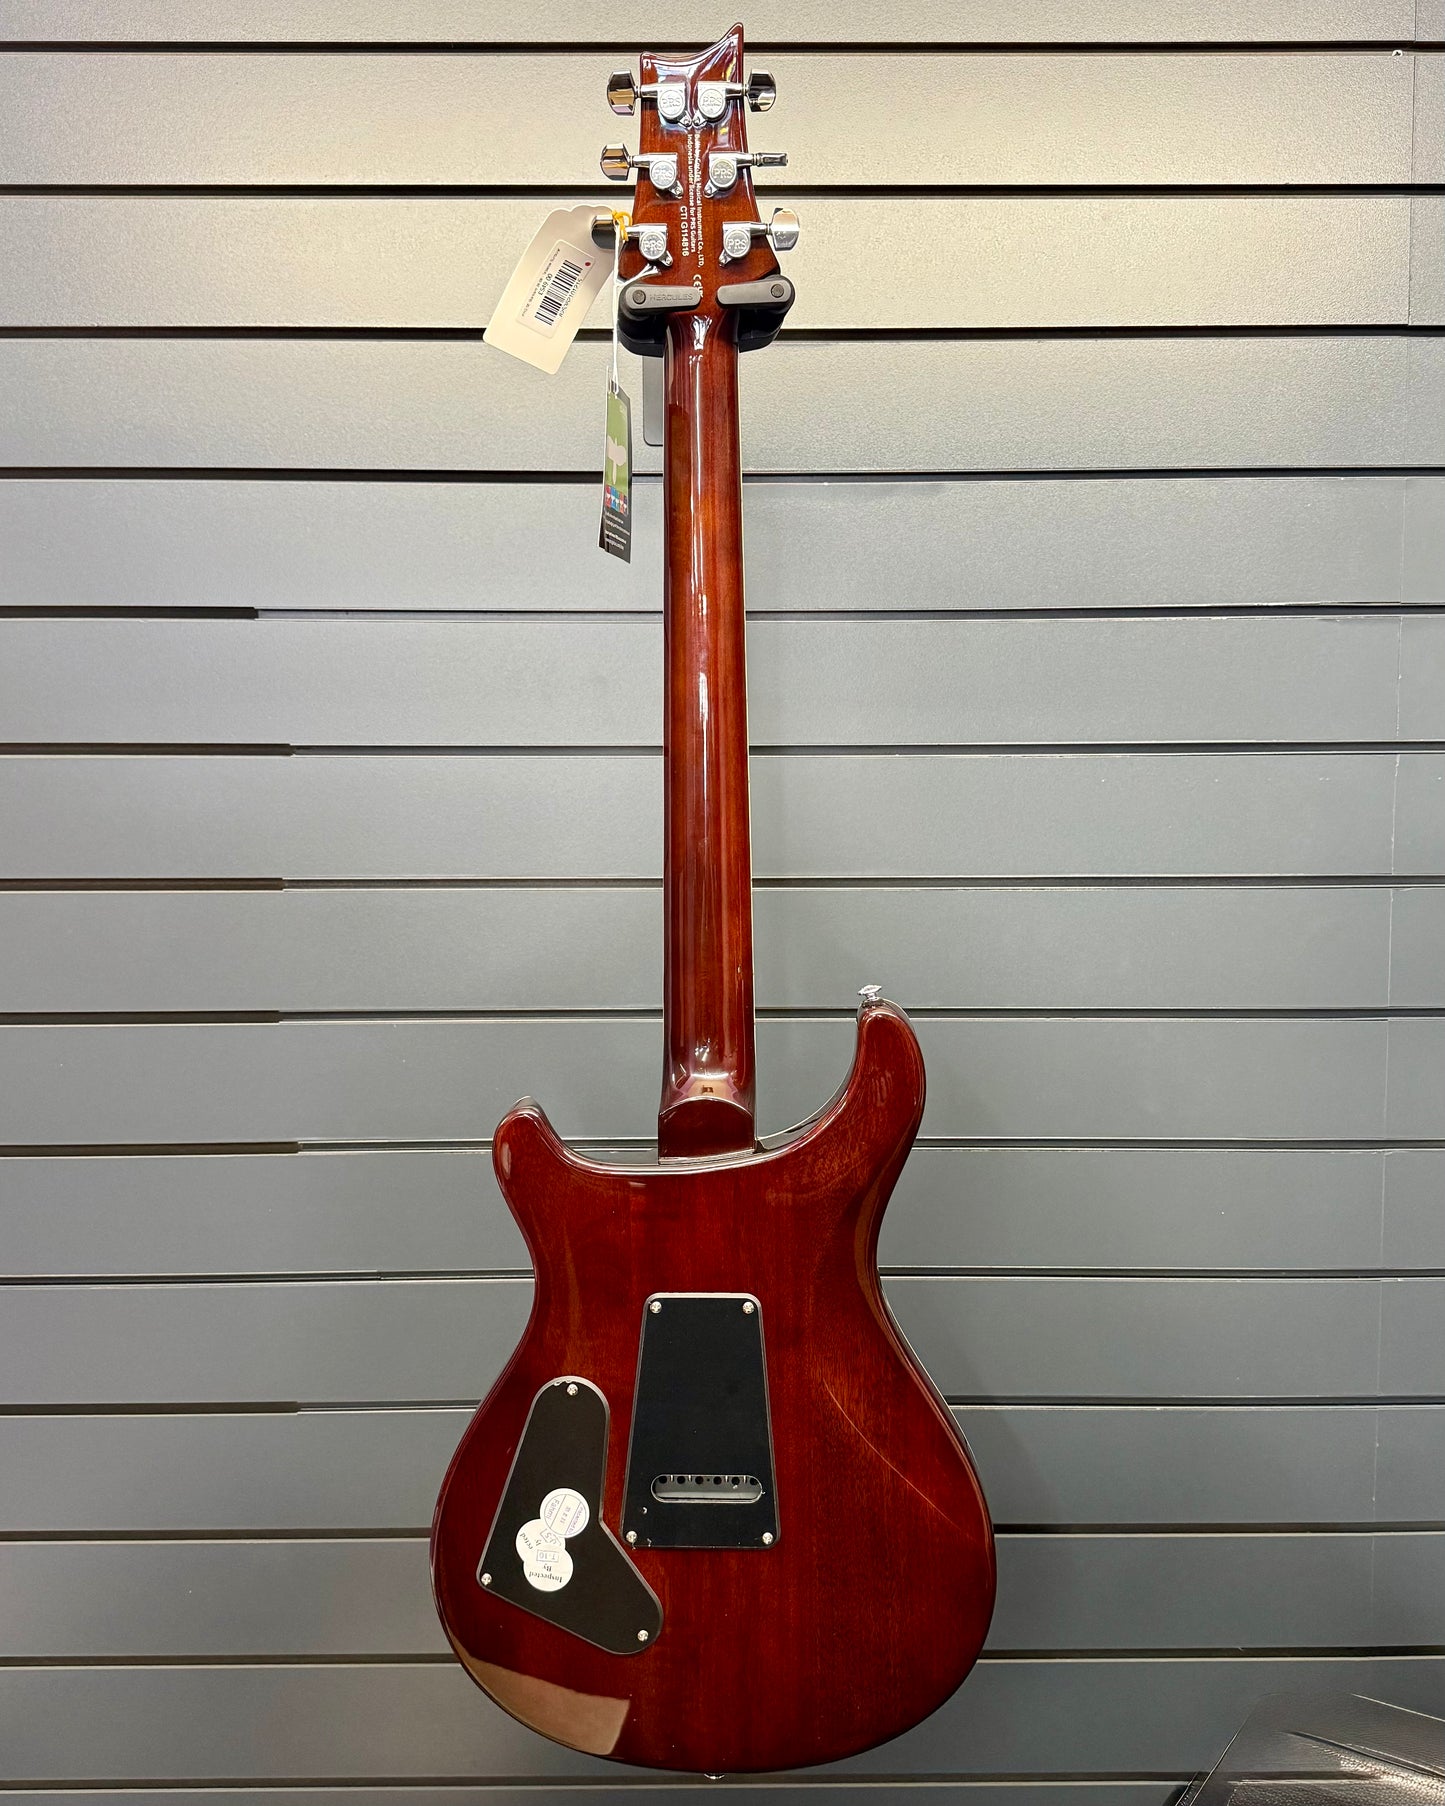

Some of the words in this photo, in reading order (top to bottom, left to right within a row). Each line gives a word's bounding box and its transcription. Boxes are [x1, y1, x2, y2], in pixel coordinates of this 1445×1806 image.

[653, 168, 674, 180] PRS
[713, 168, 734, 179] PRS
[680, 221, 689, 256] G114816
[727, 239, 747, 250] PRS
[643, 239, 664, 251] PRS
[543, 1563, 552, 1572] By
[529, 1571, 562, 1583] Inspected
